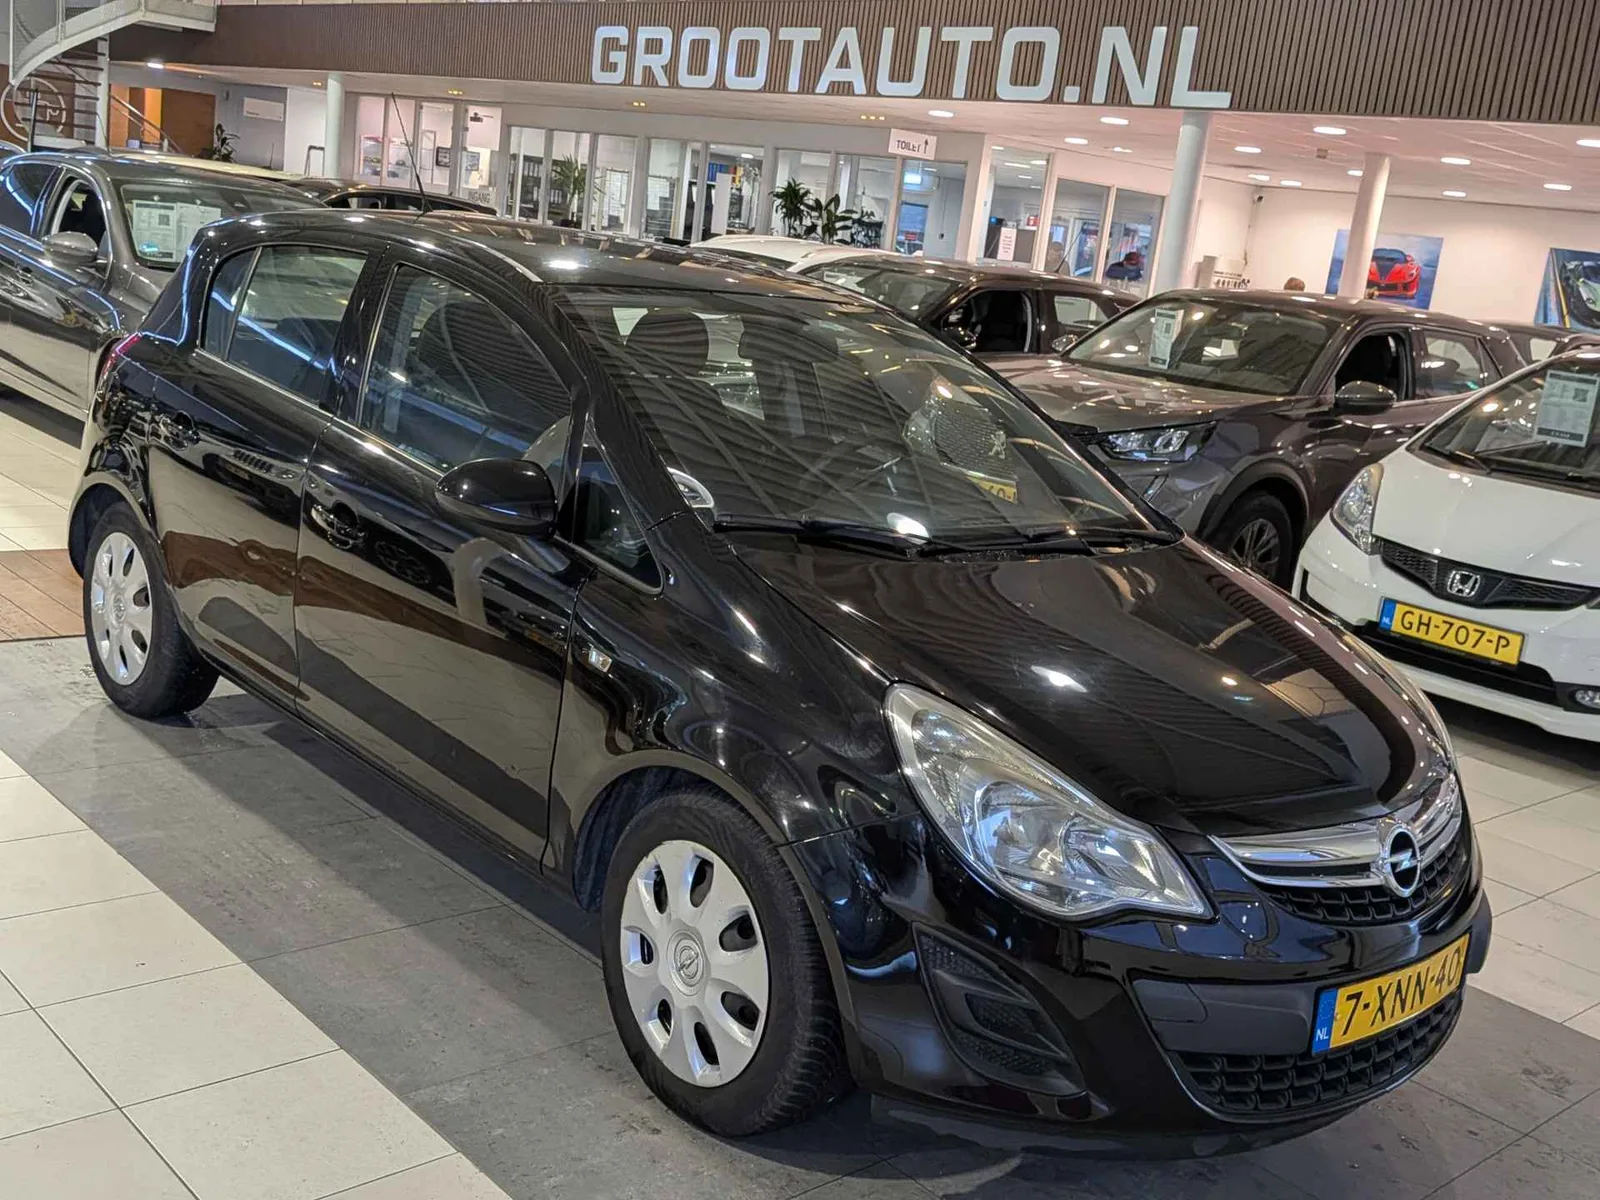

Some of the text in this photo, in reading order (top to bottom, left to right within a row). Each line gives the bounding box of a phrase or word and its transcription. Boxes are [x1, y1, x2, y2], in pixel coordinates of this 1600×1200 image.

[592, 26, 1232, 108] GROOTAUTO.NL
[896, 140, 921, 152] TOILET
[1381, 616, 1391, 624] NL
[1400, 610, 1510, 655] GH-707-P
[1341, 947, 1462, 1037] 7-XNN-40
[1315, 1028, 1329, 1041] NL
